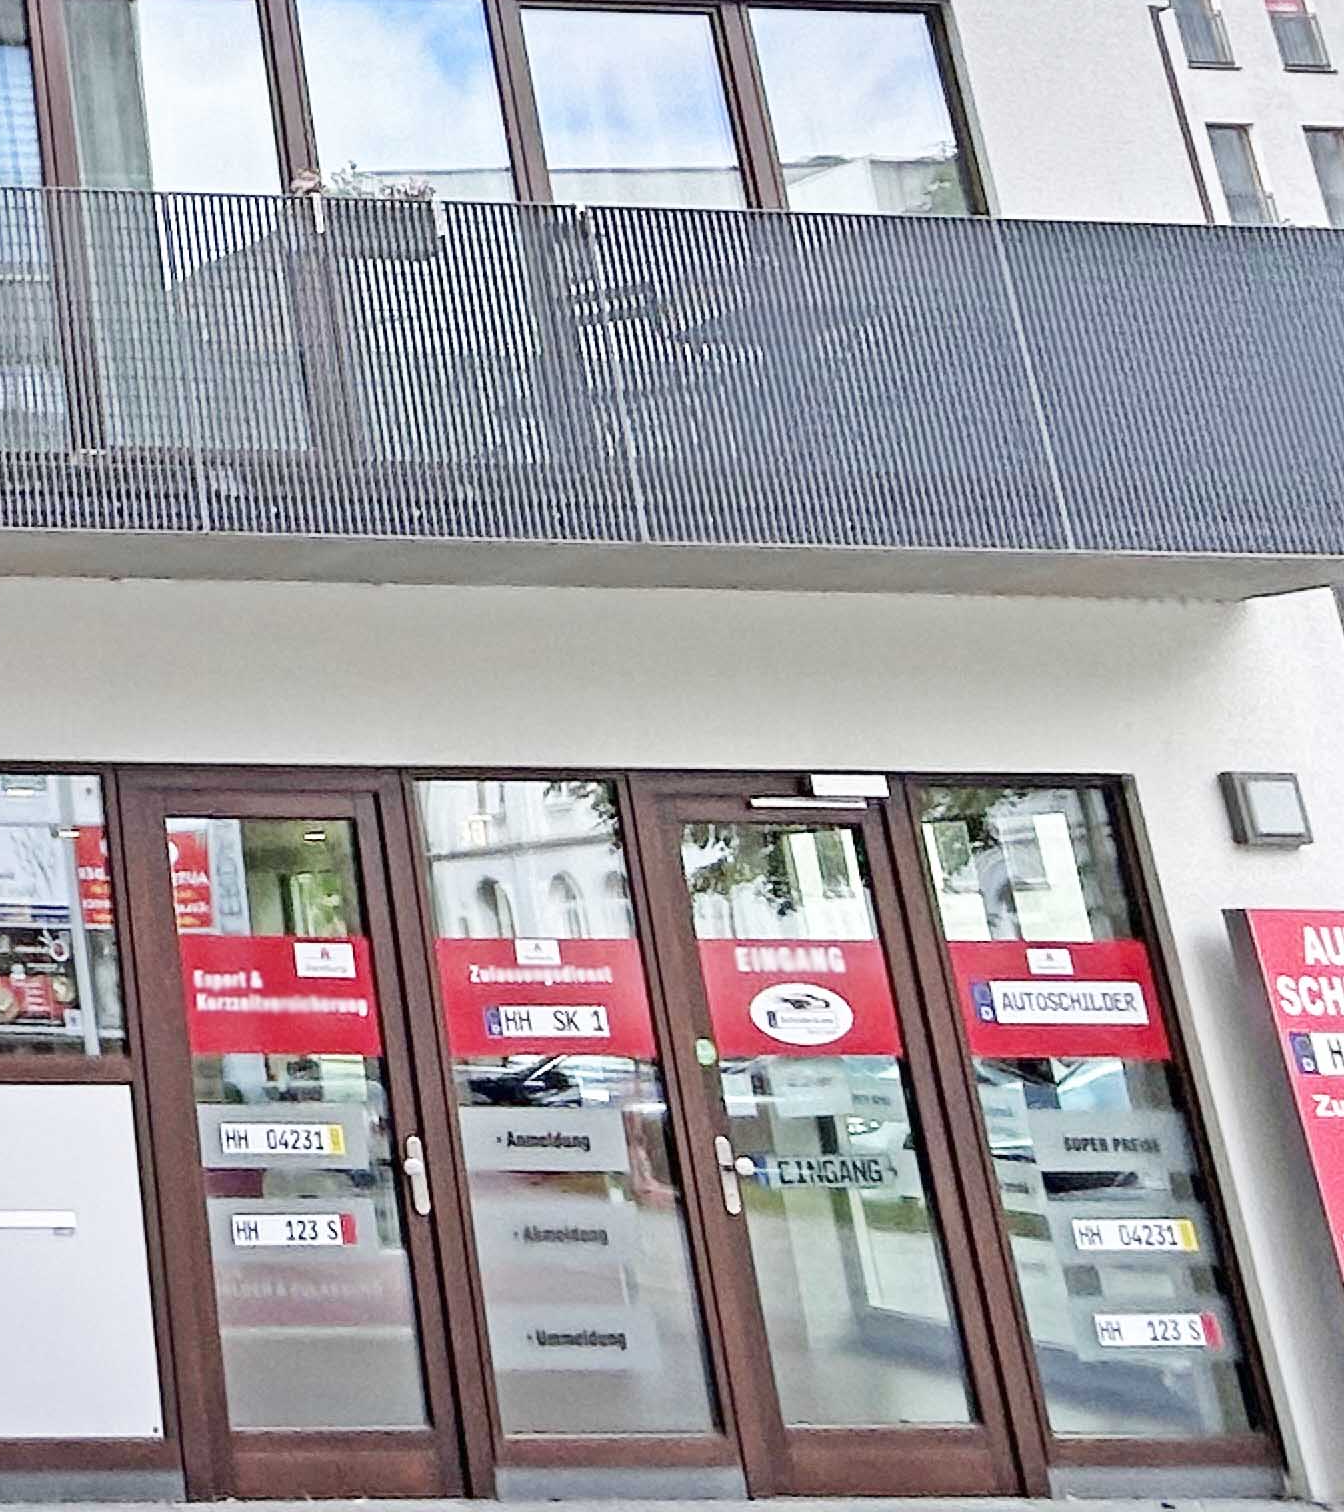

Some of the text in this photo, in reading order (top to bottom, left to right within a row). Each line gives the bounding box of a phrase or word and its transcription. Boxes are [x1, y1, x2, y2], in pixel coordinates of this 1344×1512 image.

[734, 946, 846, 974] EINGANG
[1001, 991, 1139, 1013] AUTOSCHILDER
[504, 1009, 605, 1032] HH SK 1
[225, 1128, 325, 1150] HH 04231
[507, 1131, 591, 1152] Anmeldung
[777, 1160, 883, 1184] EINGANG
[236, 1220, 339, 1241] HH 123 S
[1078, 1223, 1179, 1246] HH 04231
[1099, 1320, 1201, 1341] HH 123 S
